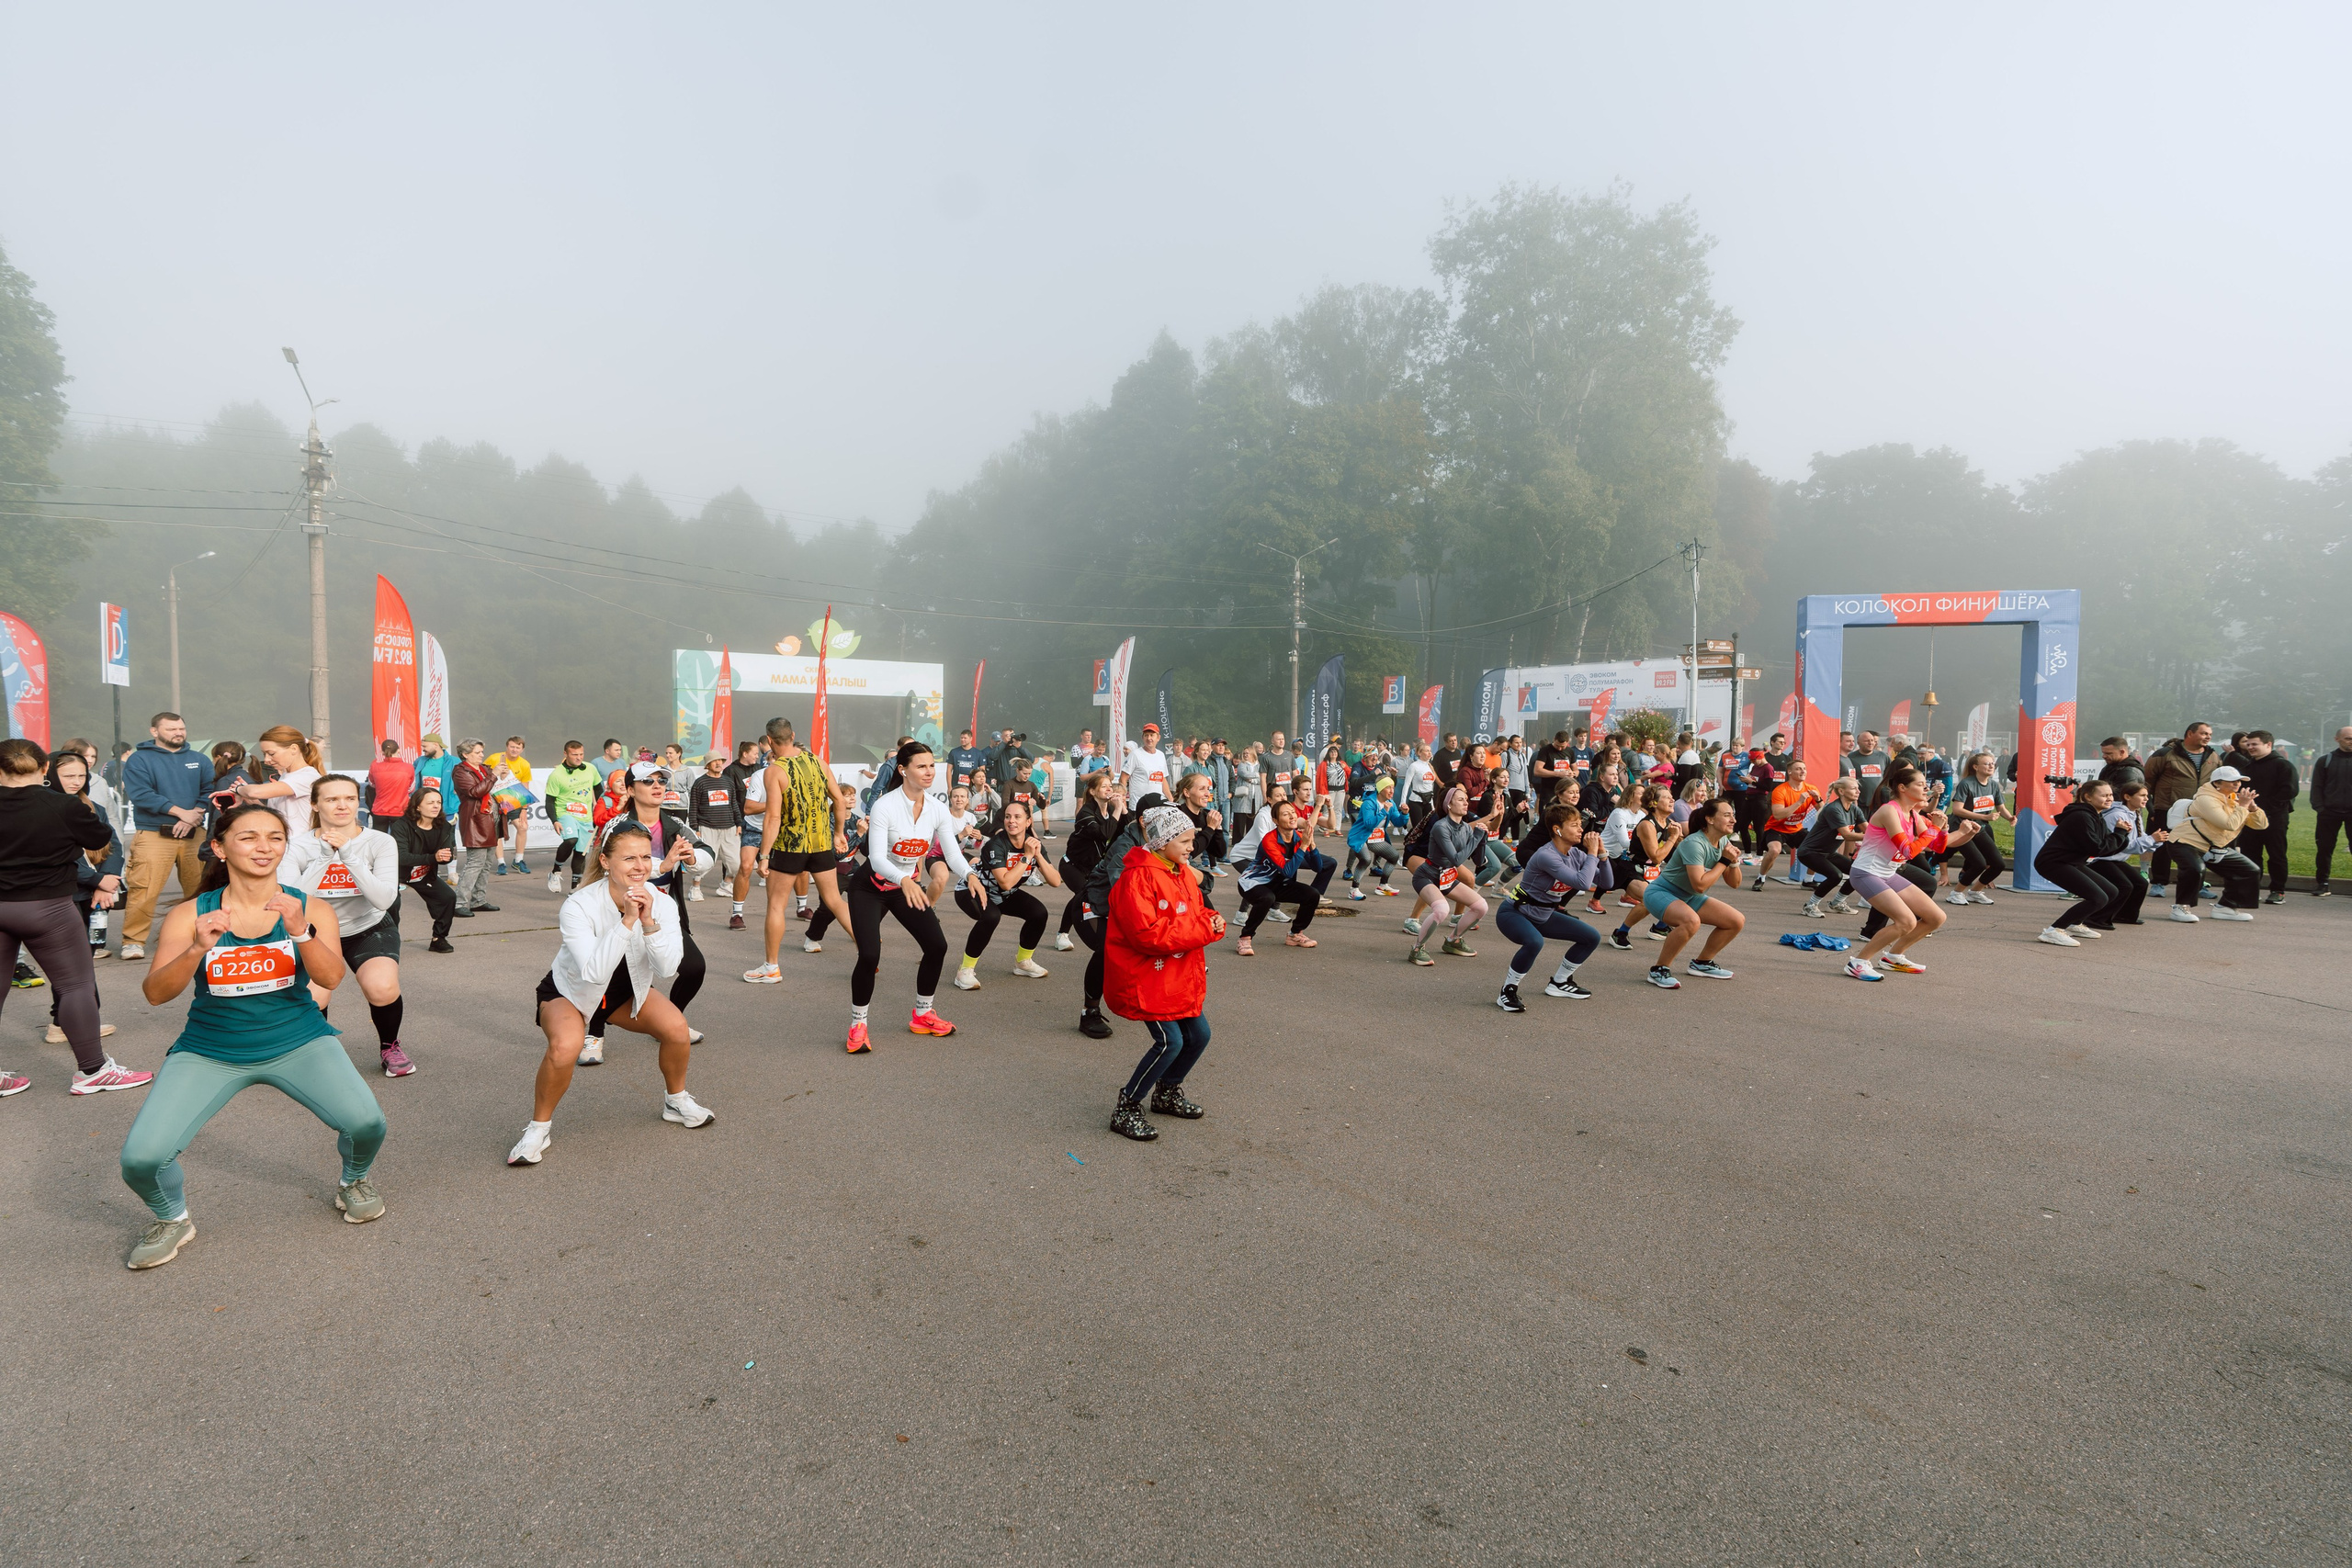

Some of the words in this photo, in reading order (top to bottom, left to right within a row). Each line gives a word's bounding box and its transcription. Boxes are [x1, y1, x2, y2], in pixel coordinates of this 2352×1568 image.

[1835, 598, 1929, 615] КОЛОКОЛ
[1936, 593, 2050, 612] ФИНИШЁРА
[112, 622, 124, 659] D
[771, 673, 808, 685] МАМА
[810, 675, 819, 685] И
[826, 676, 866, 688] МАЛЫШ
[805, 666, 831, 674] СКР
[1589, 678, 1634, 686] ПОЛУМАРАФОН
[1388, 684, 1398, 702] B
[1159, 690, 1170, 739] K-HOLDING
[1479, 682, 1492, 730] ЭВОКОМ
[1846, 705, 1855, 732] ВОКОМ
[2041, 747, 2049, 768] ТУЛА
[2058, 748, 2066, 777] ЭВОКО
[2049, 747, 2058, 804] ПОЛУМААФОН
[903, 845, 923, 853] 2136
[322, 874, 354, 884] 2036
[214, 966, 222, 976] D
[227, 958, 276, 976] 2260
